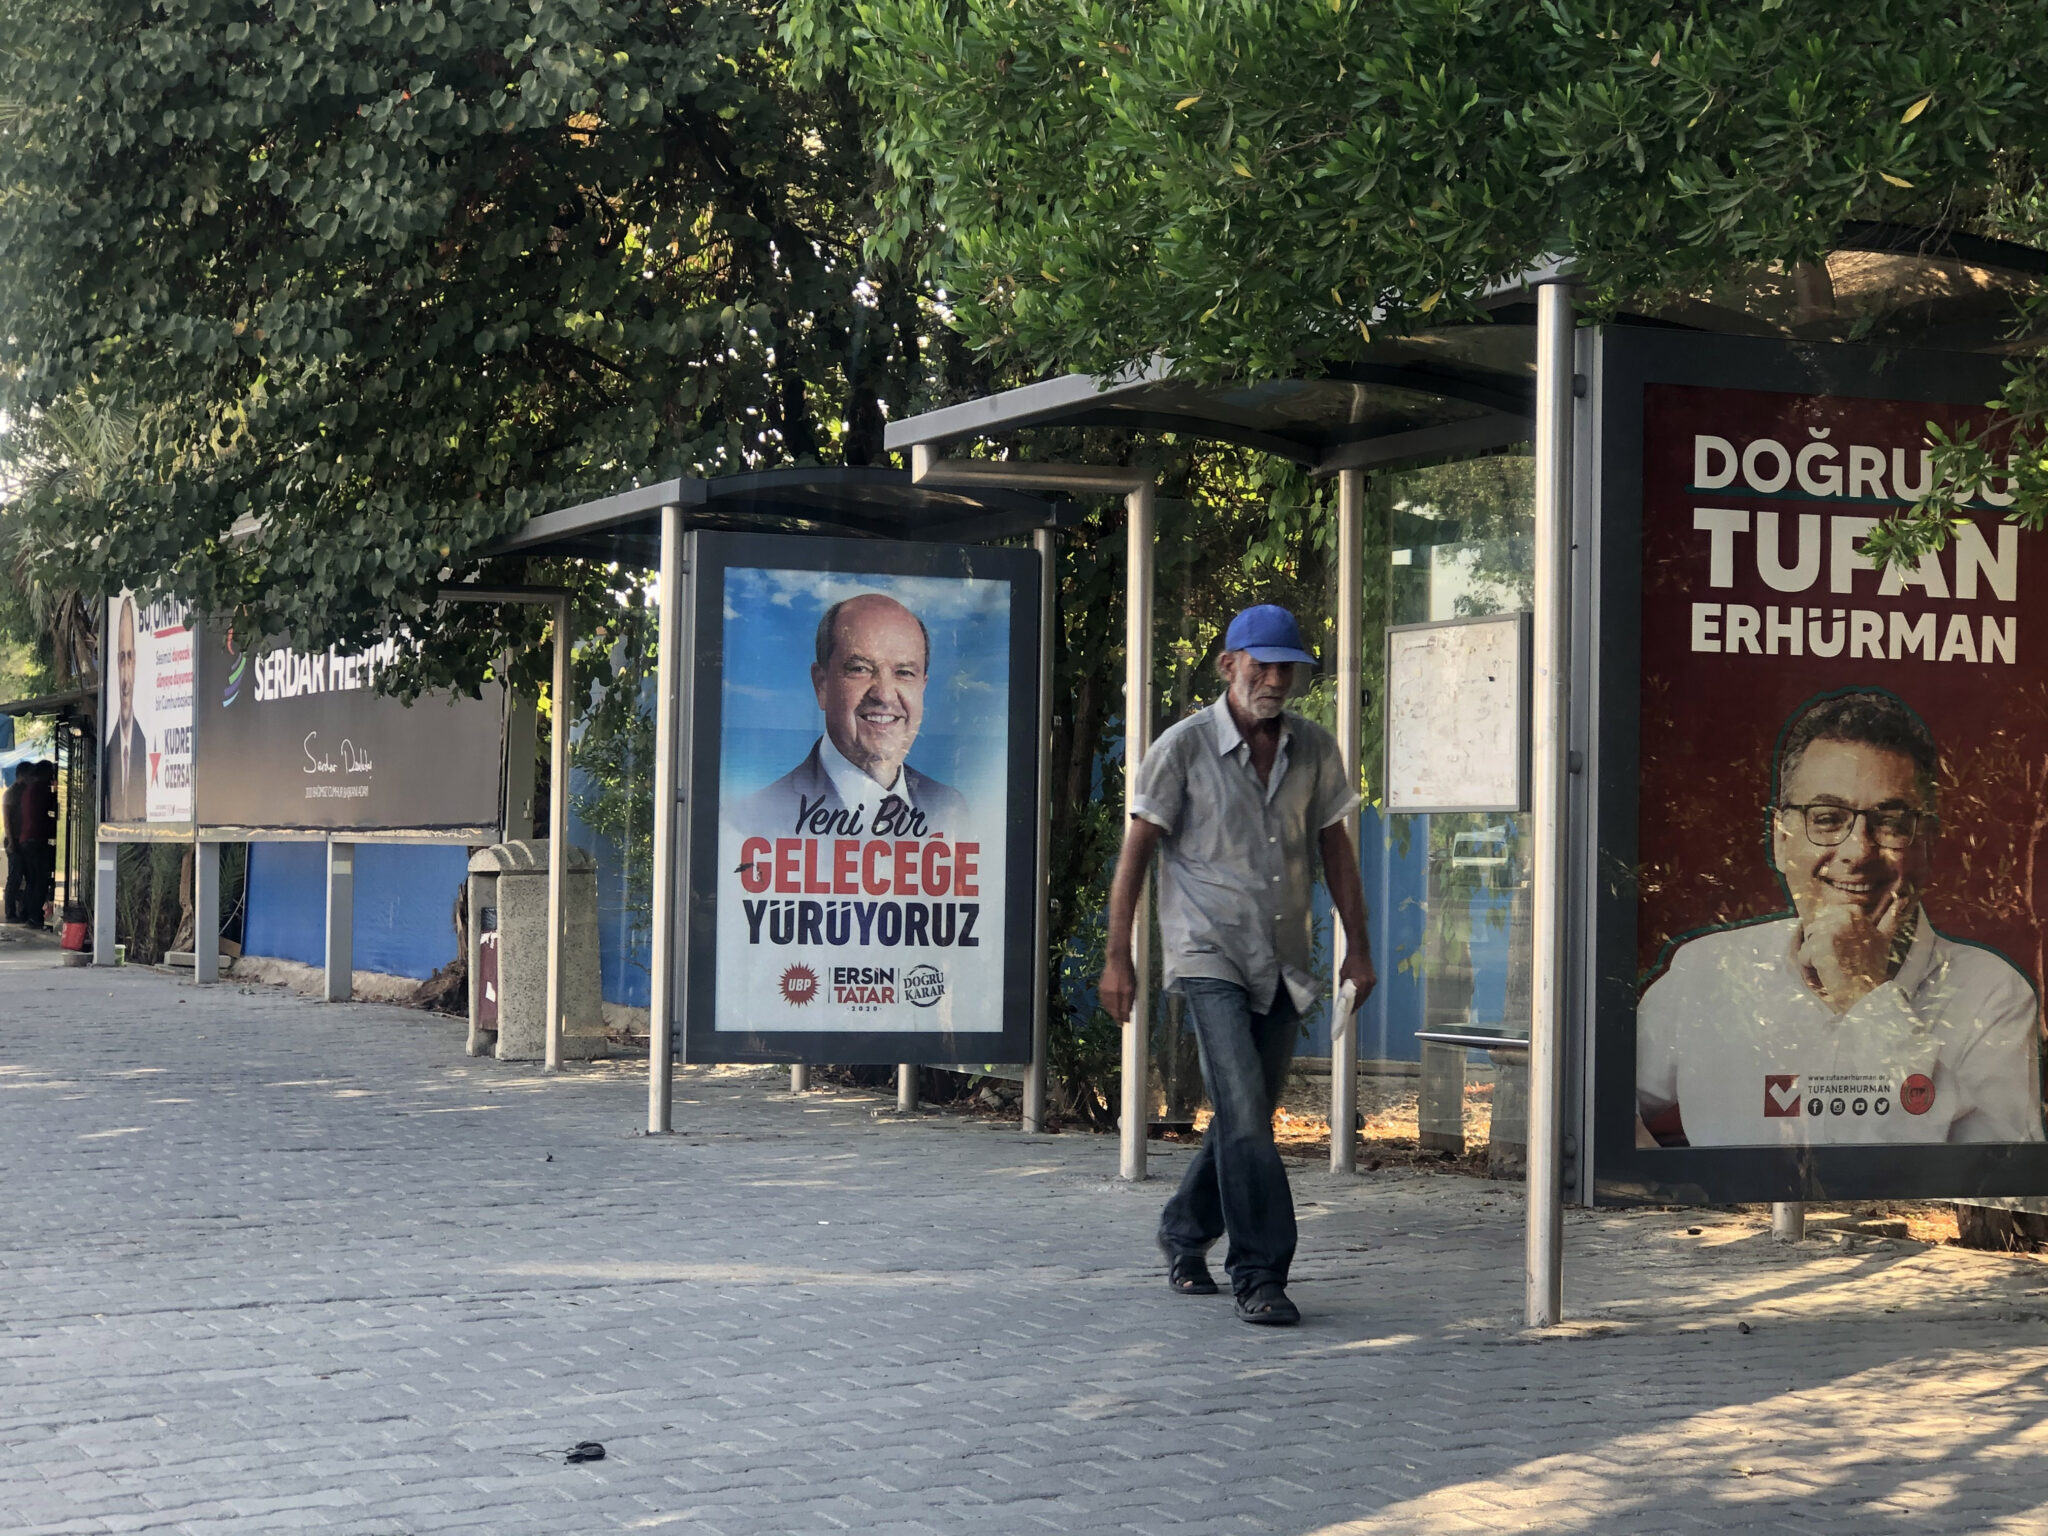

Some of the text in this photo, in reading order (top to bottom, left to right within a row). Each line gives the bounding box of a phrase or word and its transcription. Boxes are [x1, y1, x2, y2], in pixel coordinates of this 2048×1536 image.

[1693, 507, 2018, 602] TUFAN
[1691, 602, 2017, 664] ERHÜRMAN
[795, 793, 928, 838] Yeni Bir
[740, 832, 980, 896] GELECEĞE
[742, 900, 980, 947] YÜRÜYORUZ
[788, 978, 812, 992] UBP
[834, 967, 895, 985] ERSİN
[903, 972, 944, 989] DOĞRU
[834, 986, 896, 1004] TATAR
[904, 984, 946, 1001] KARAR
[1808, 1085, 1891, 1094] TUFANERHURMAN
